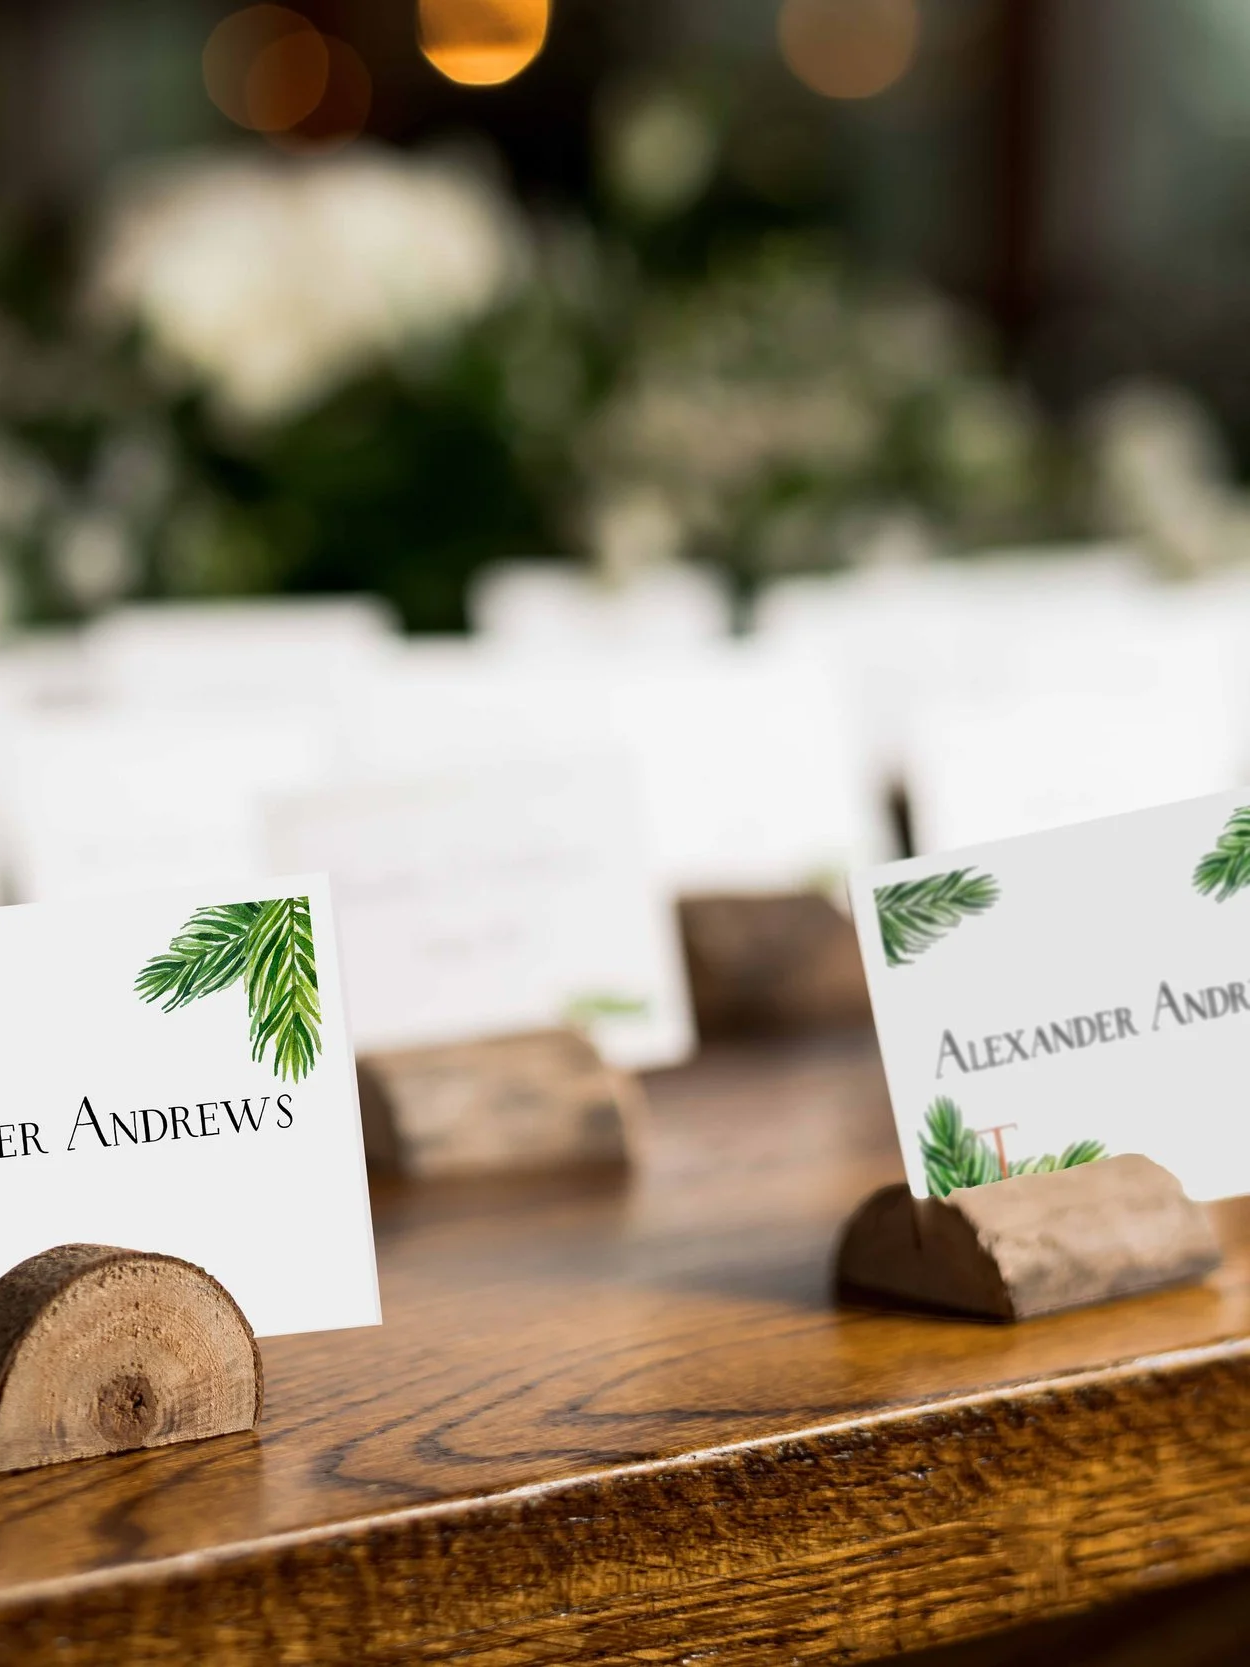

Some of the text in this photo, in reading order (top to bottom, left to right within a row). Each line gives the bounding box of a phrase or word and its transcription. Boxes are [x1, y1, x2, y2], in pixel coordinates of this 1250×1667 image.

[935, 980, 1250, 1080] ALEXANDER ANDR
[66, 1093, 294, 1152] ANDREWS
